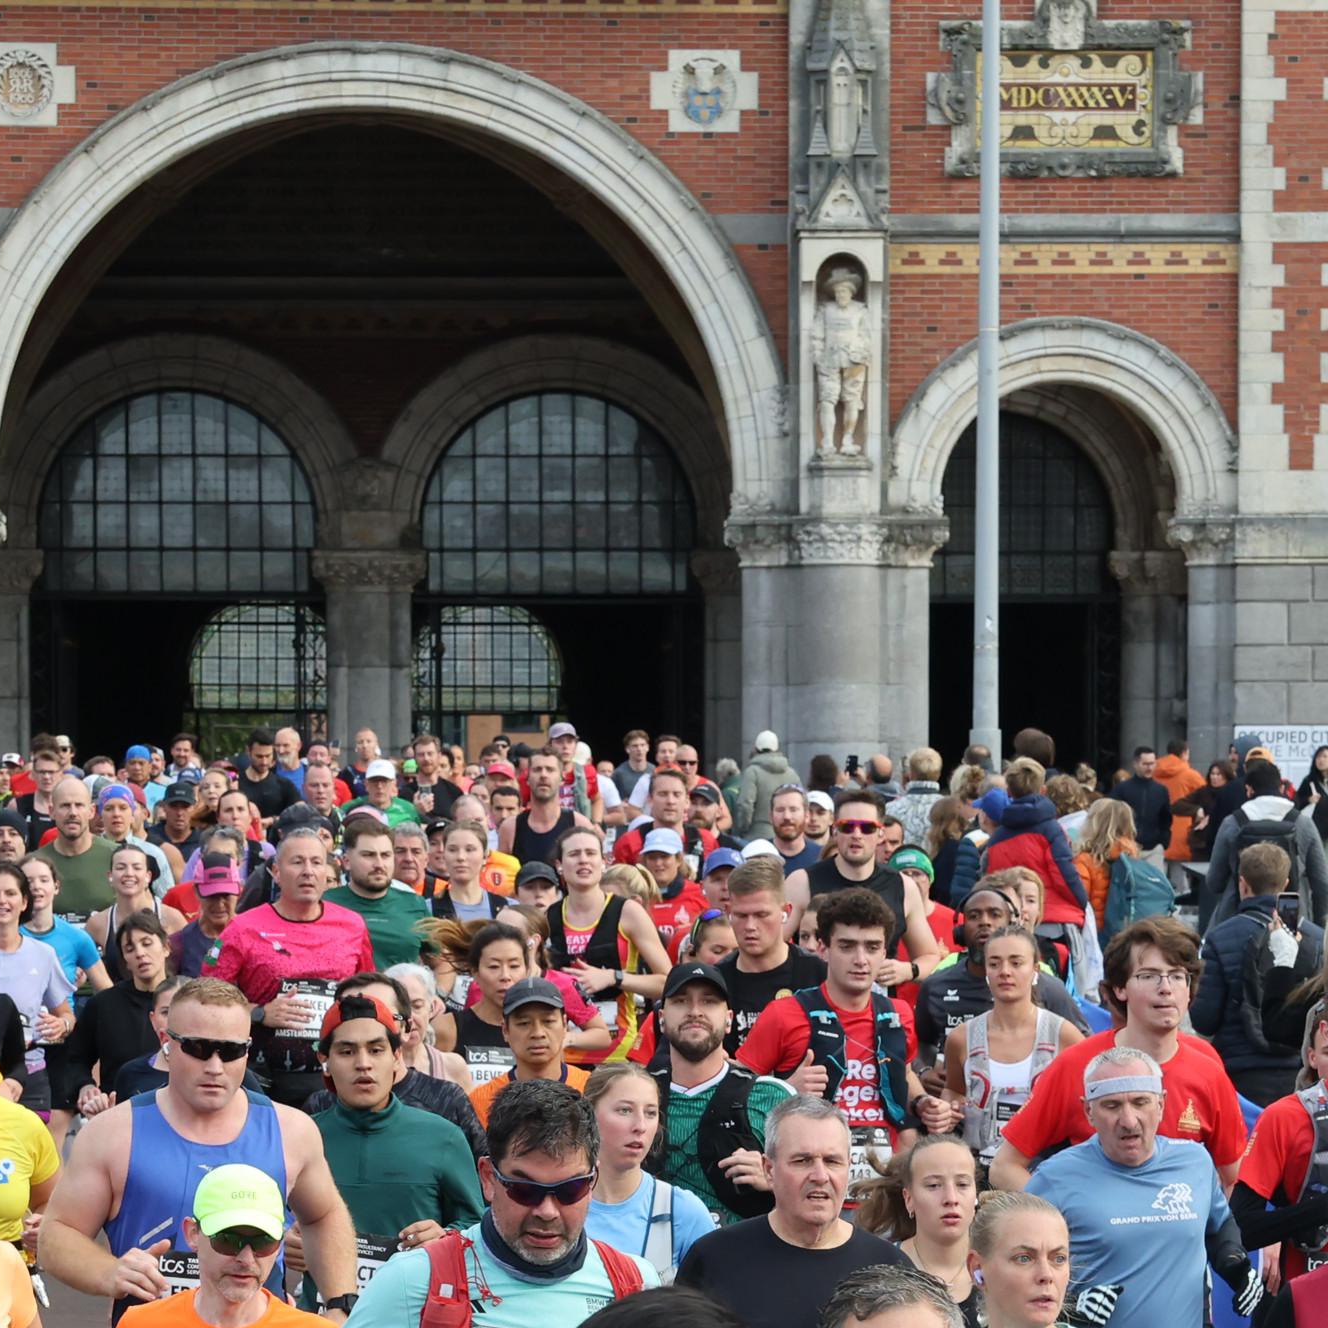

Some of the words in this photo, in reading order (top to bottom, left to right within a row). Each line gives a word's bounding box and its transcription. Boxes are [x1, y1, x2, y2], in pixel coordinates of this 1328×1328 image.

[468, 1051, 488, 1063] tcs
[1110, 1216, 1140, 1225] GRAND
[1142, 1215, 1160, 1224] PRIX
[1160, 1214, 1179, 1222] VON
[159, 1255, 184, 1274] tcs
